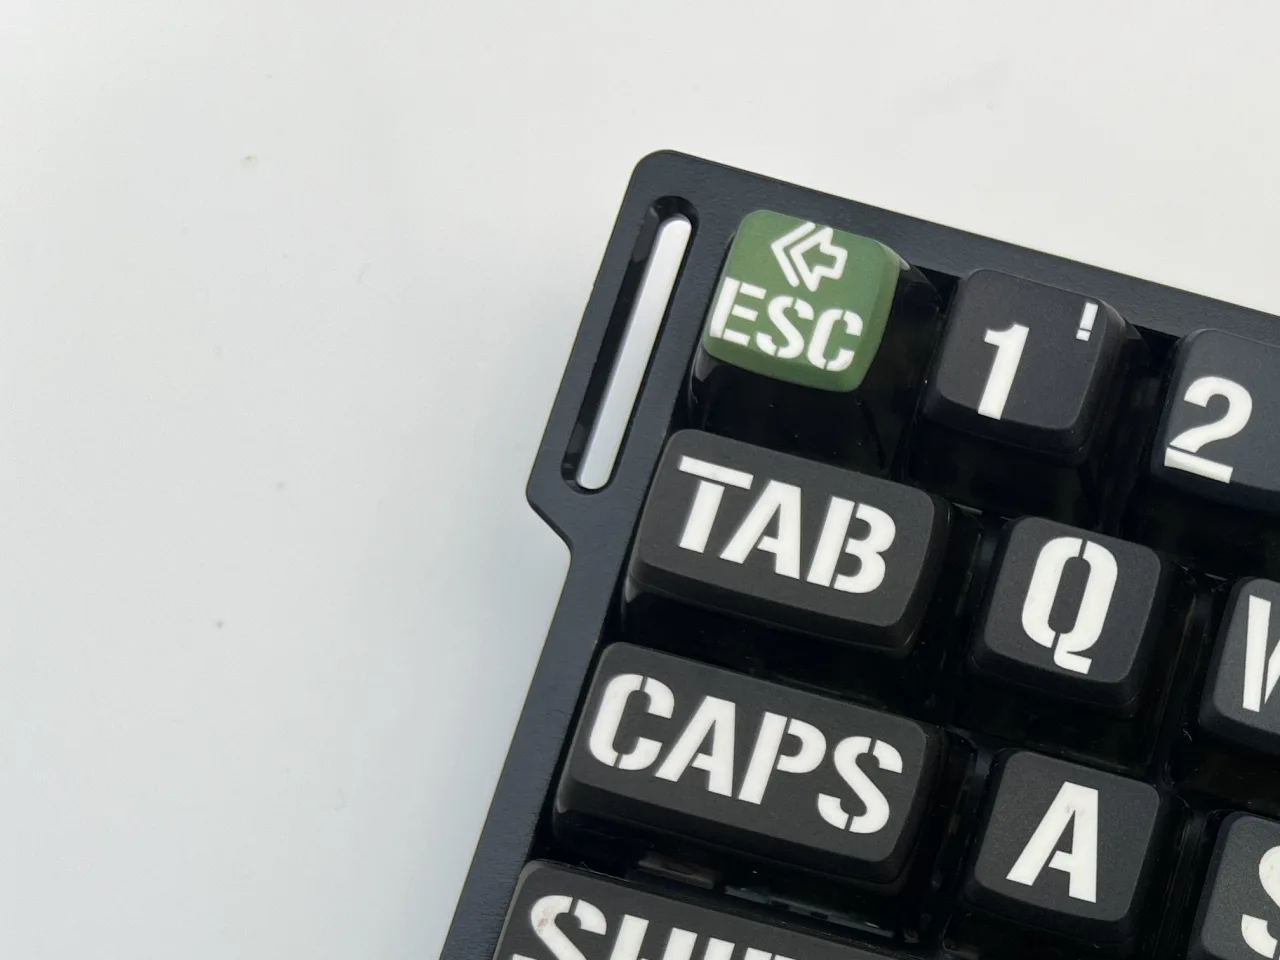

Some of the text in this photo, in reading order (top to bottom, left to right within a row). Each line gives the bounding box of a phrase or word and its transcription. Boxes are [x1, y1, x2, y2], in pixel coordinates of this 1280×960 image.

[709, 278, 863, 373] ESC
[977, 323, 1030, 420] 1
[1076, 302, 1099, 342] !
[1164, 376, 1253, 483] 2
[677, 456, 897, 594] TAB
[1020, 536, 1119, 674] Q
[588, 673, 904, 834] CAPS
[1006, 781, 1102, 904] A
